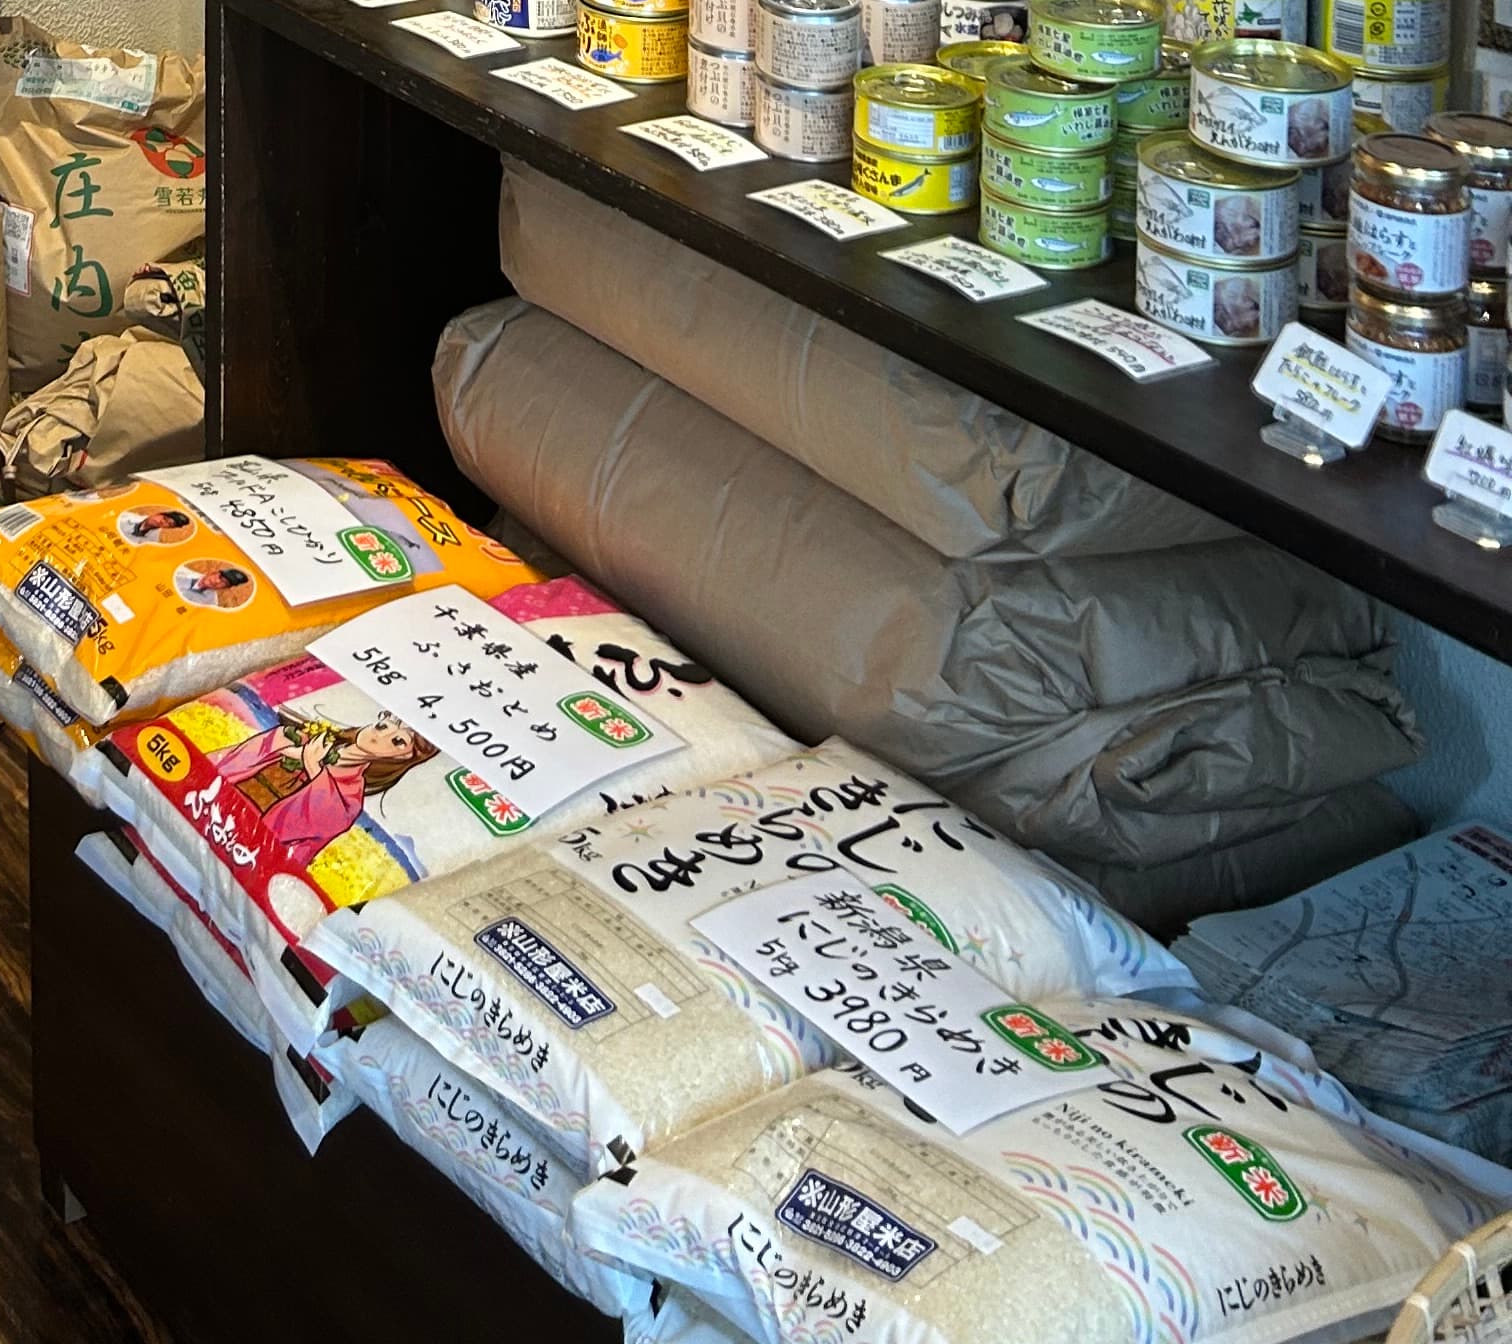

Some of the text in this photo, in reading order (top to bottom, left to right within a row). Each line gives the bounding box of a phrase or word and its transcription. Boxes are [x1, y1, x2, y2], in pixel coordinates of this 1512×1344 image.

[351, 531, 403, 574] 新米
[87, 618, 116, 655] 5kg
[352, 647, 408, 685] 5kg
[431, 605, 542, 679] 千葉県産
[414, 639, 558, 743] ふさおとめ
[576, 698, 638, 739] 新米
[145, 734, 183, 775] 5kg
[460, 774, 520, 825] 新米
[559, 826, 602, 862] 5kg
[815, 890, 952, 982] 新潟県
[430, 951, 551, 1074] にじのきらめき
[756, 938, 933, 1083] 5kg 3980円
[778, 910, 1025, 1075] にじのきらめき
[999, 1014, 1083, 1063] 新米
[428, 1074, 550, 1190] にじのきらめき
[1090, 1124, 1112, 1139] no
[1115, 1139, 1194, 1206] kirameki
[1200, 1132, 1289, 1208] 新米
[727, 1213, 868, 1335] にじのきらめき
[1217, 1257, 1326, 1317] にじのきらめき
